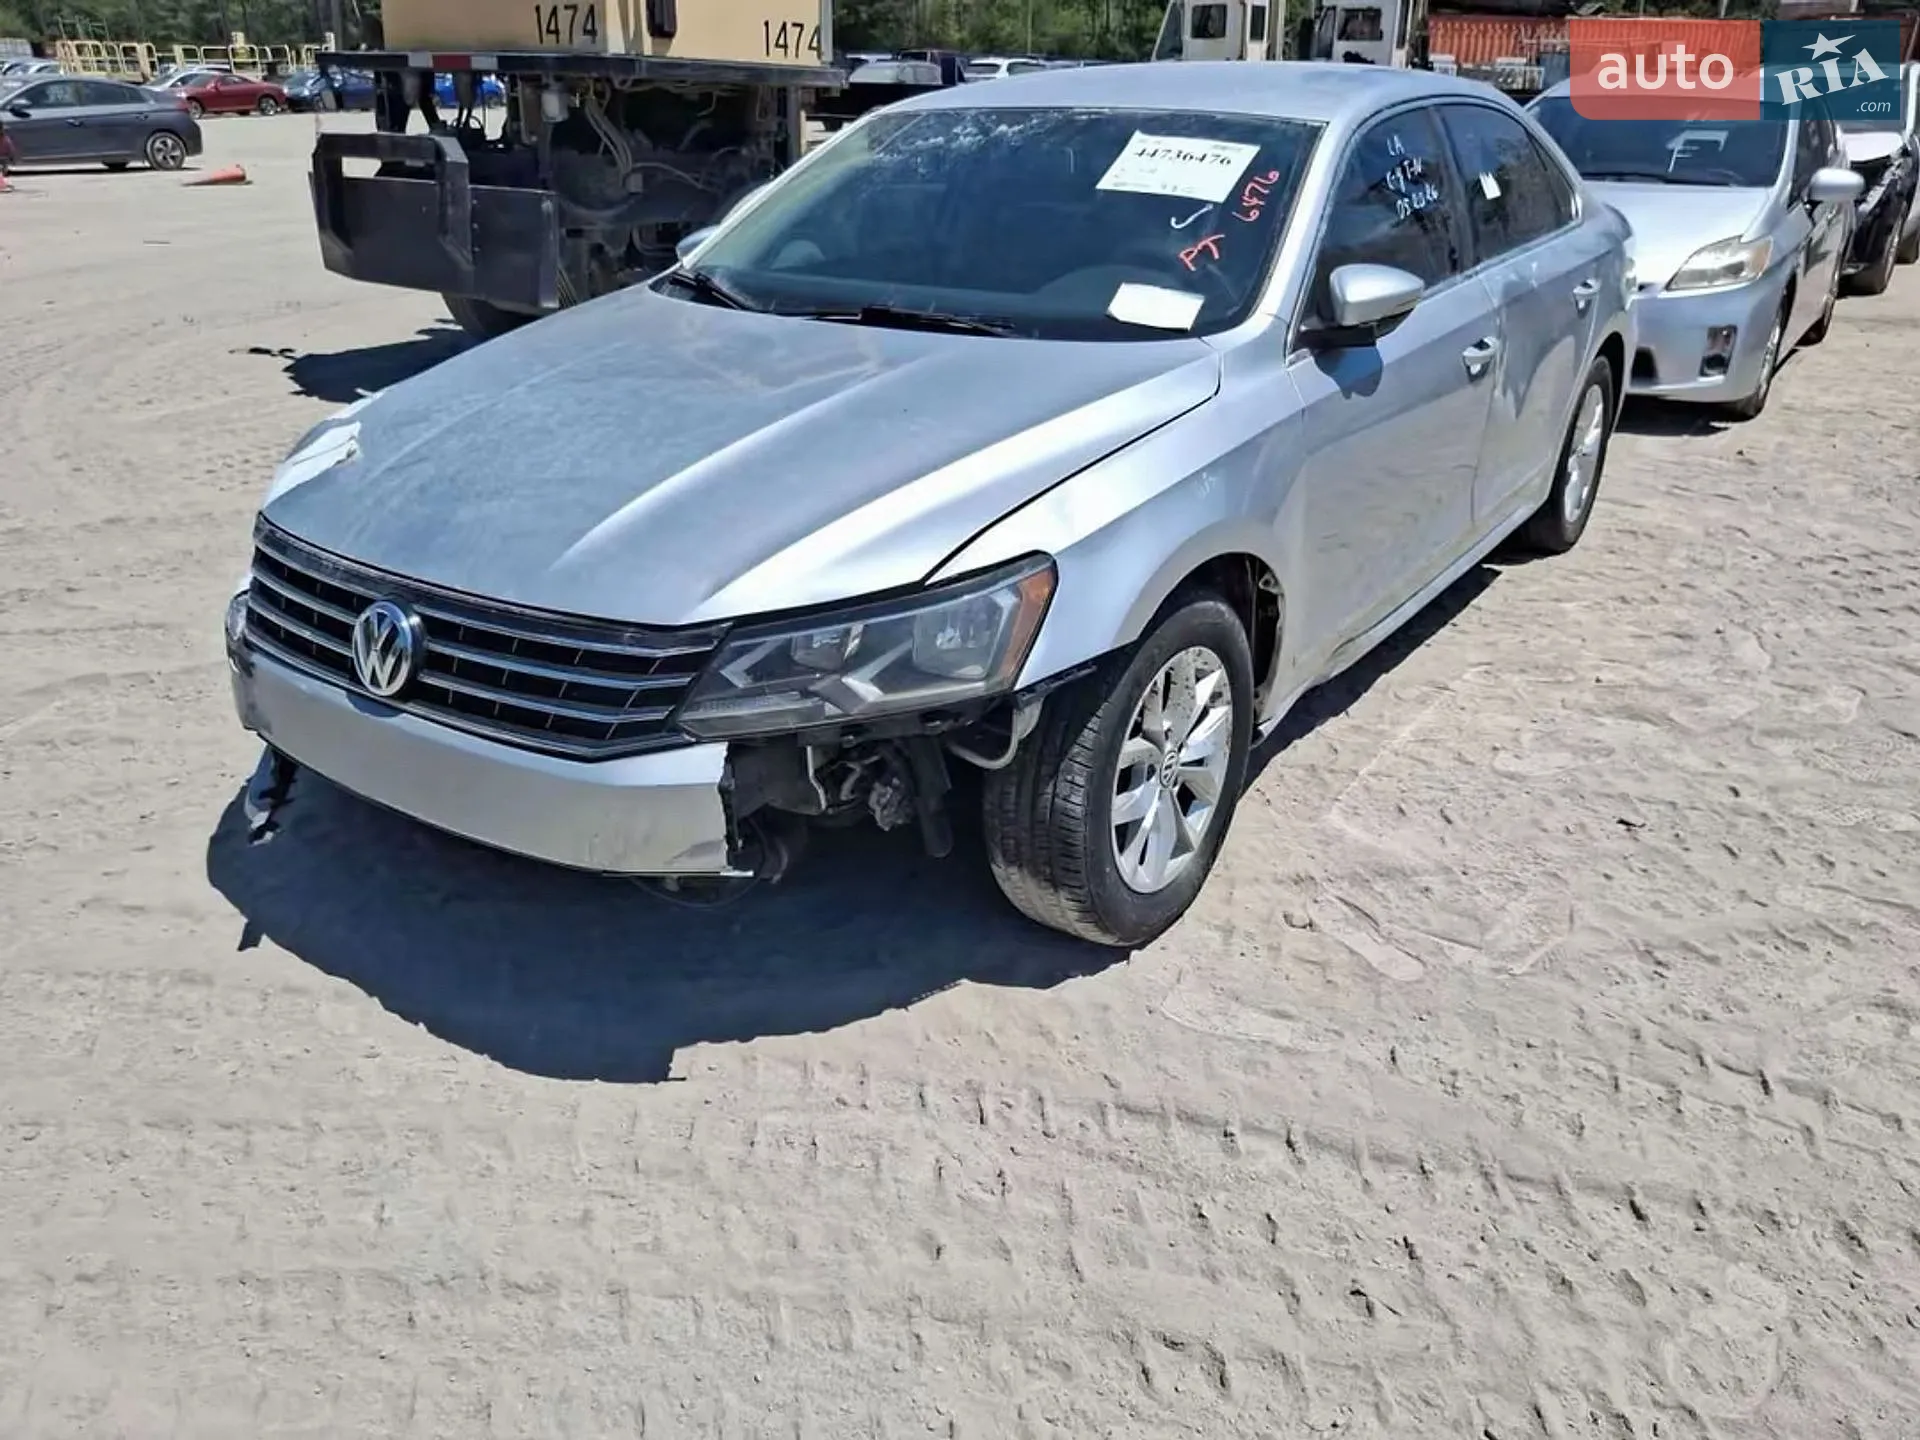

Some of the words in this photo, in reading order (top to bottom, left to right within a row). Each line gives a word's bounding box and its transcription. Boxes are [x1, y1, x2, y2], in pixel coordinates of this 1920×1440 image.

[535, 3, 598, 45] 1474
[763, 19, 823, 60] 1474
[1134, 148, 1232, 166] 44736476
[1231, 170, 1280, 222] 6476
